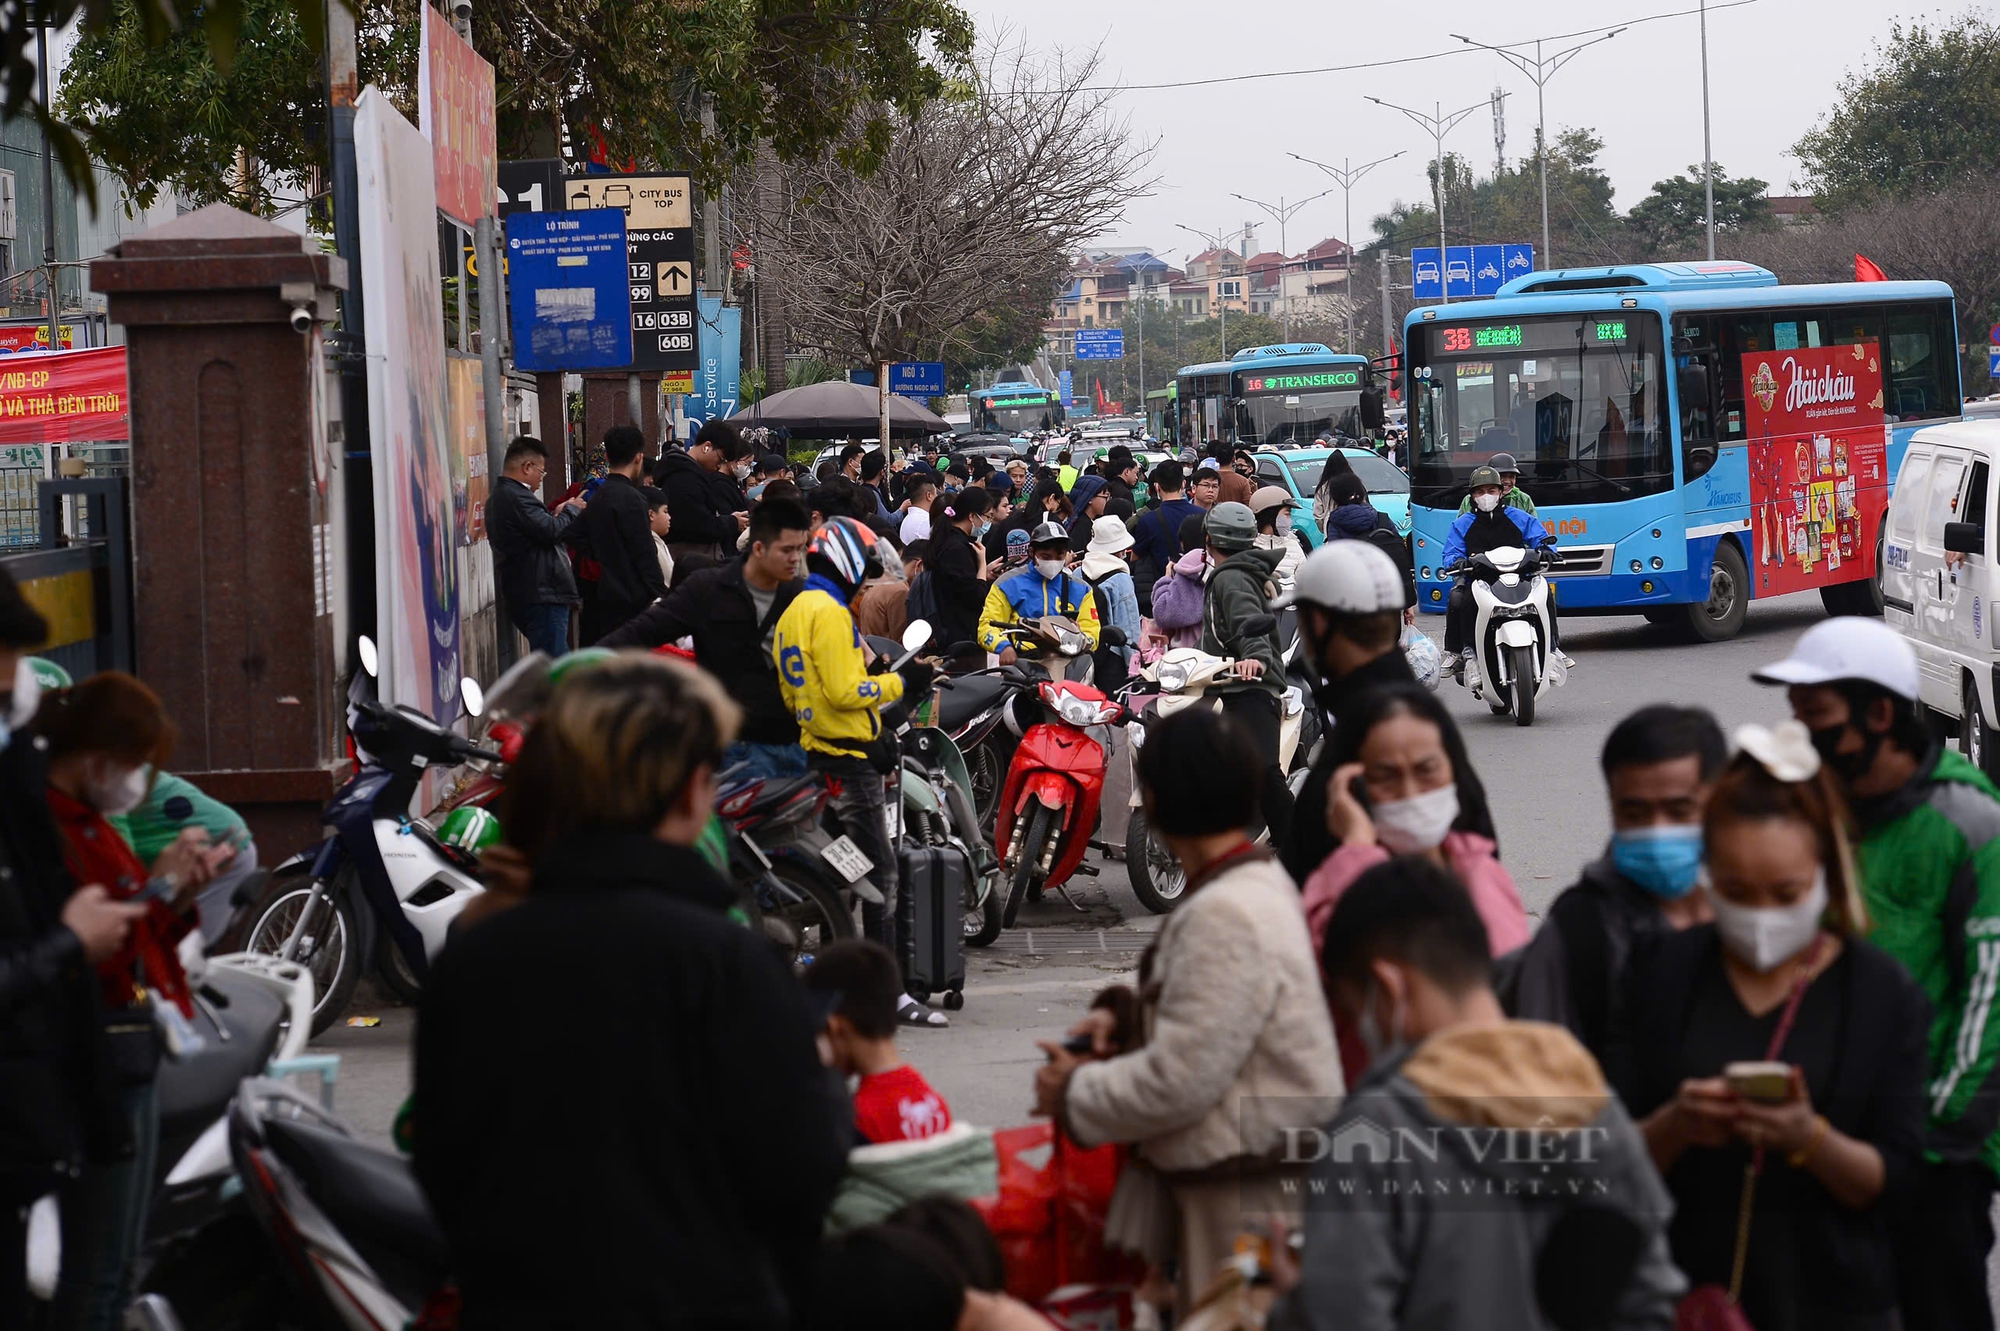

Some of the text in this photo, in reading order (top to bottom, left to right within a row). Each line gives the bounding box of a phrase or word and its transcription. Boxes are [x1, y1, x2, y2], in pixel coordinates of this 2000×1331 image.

[640, 190, 660, 198] CITY
[546, 220, 579, 232] LỘ TRÌNH
[652, 231, 674, 240] CÁC
[631, 265, 648, 277] 12
[631, 288, 649, 300] 99
[637, 313, 688, 327] 16 03B
[662, 336, 690, 349] 60B
[920, 367, 925, 378] 3
[704, 358, 716, 408] Service
[1248, 372, 1357, 390] 16 TRANSERCO
[6, 395, 24, 416] VÀ
[28, 394, 55, 415] THẢ
[58, 393, 85, 414] ĐÈN
[87, 391, 120, 412] TRỜI
